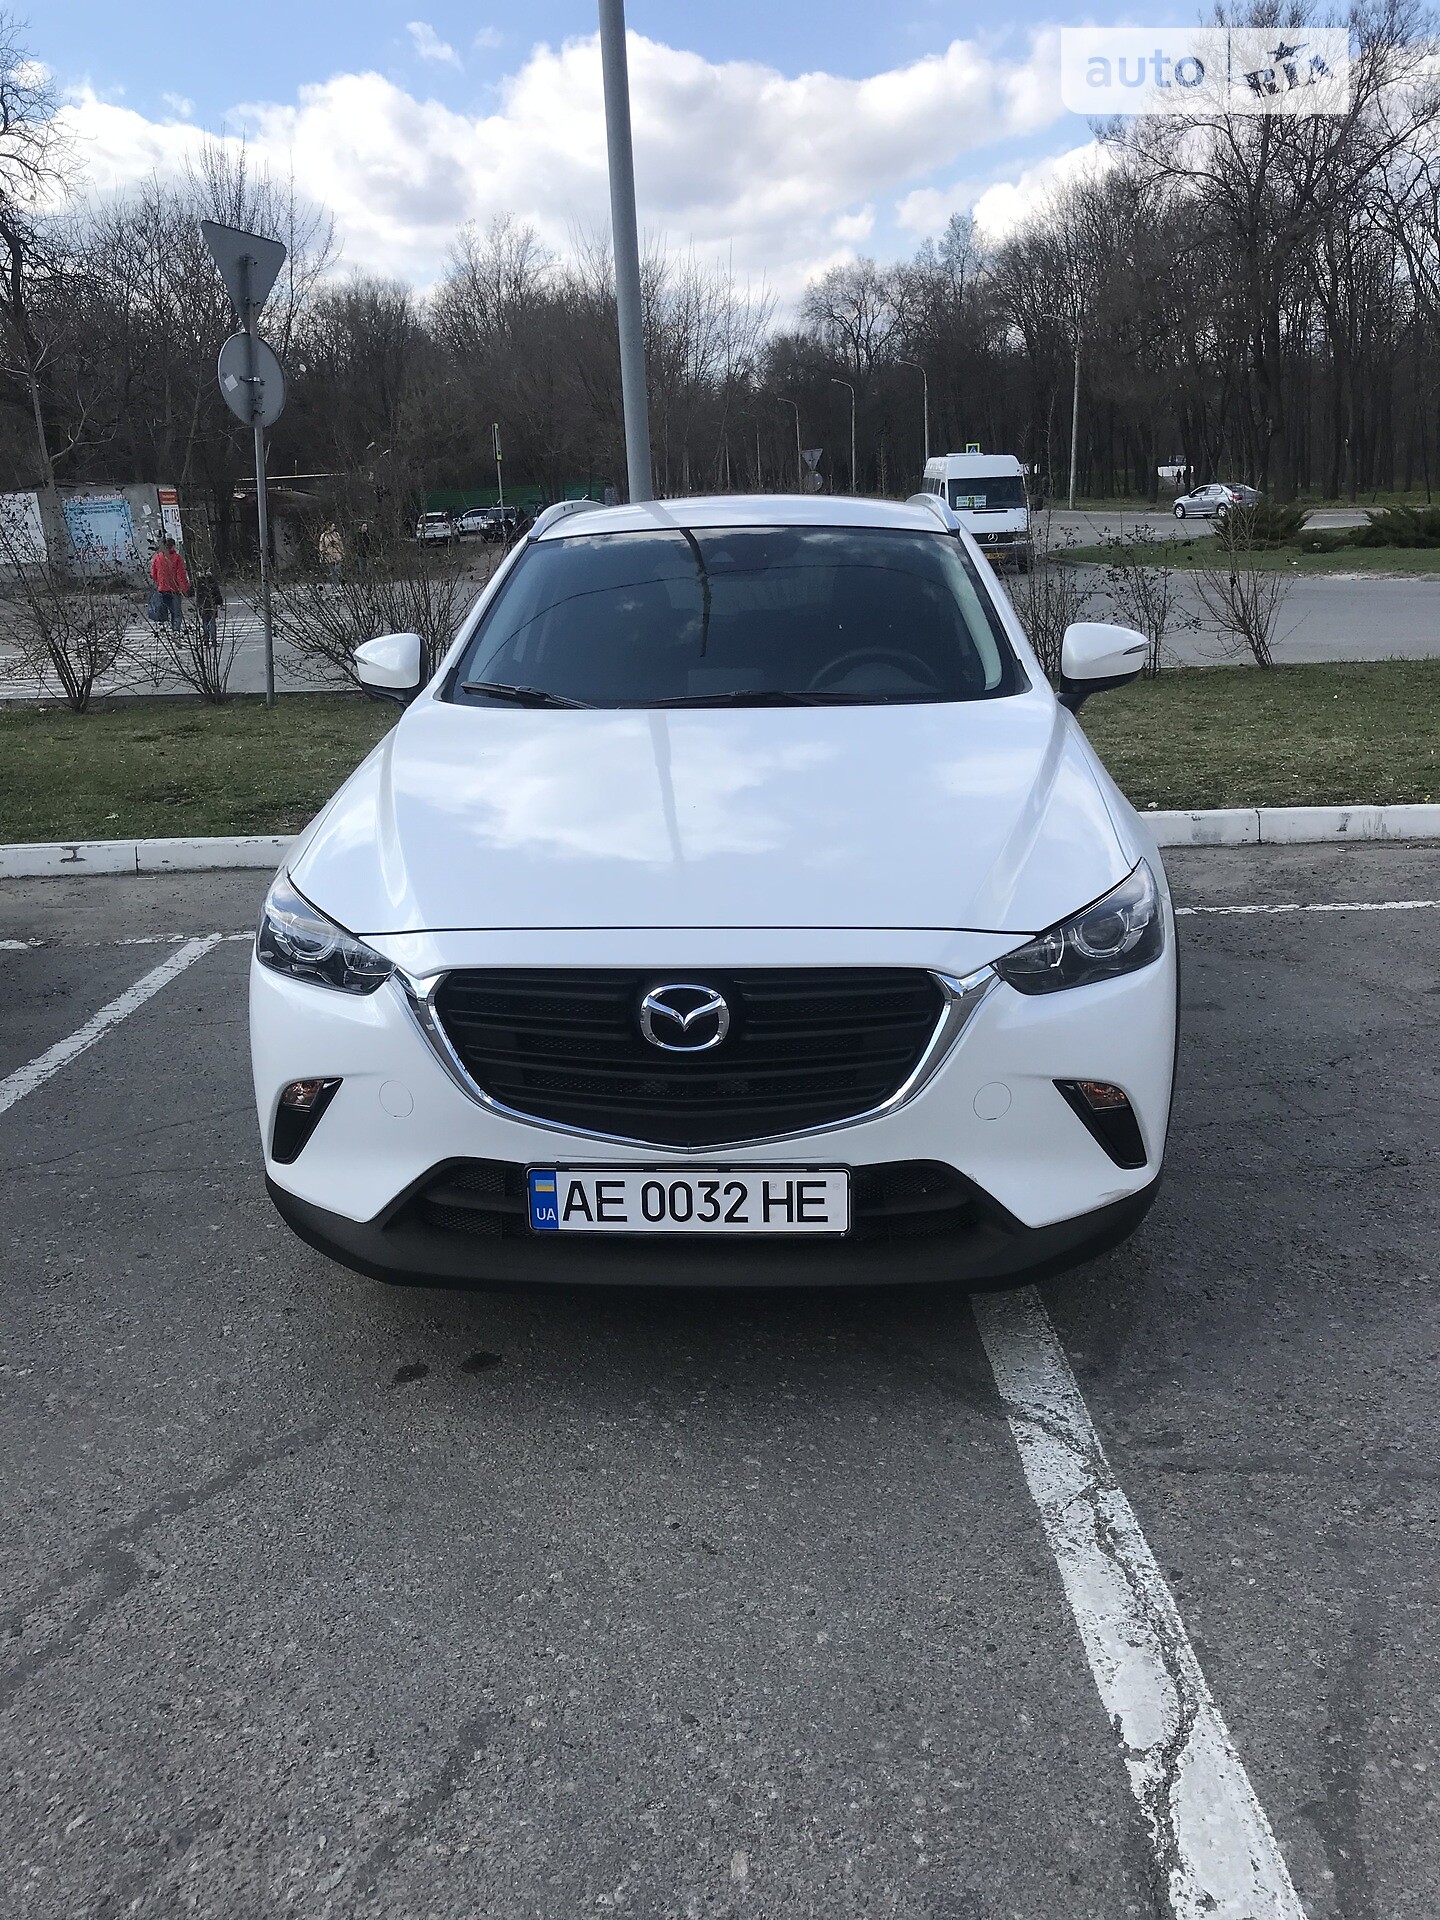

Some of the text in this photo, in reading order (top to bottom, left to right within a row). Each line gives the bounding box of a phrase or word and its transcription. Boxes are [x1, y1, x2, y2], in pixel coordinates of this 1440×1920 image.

[536, 1207, 556, 1221] UA
[562, 1180, 828, 1223] AE 0032 HE
